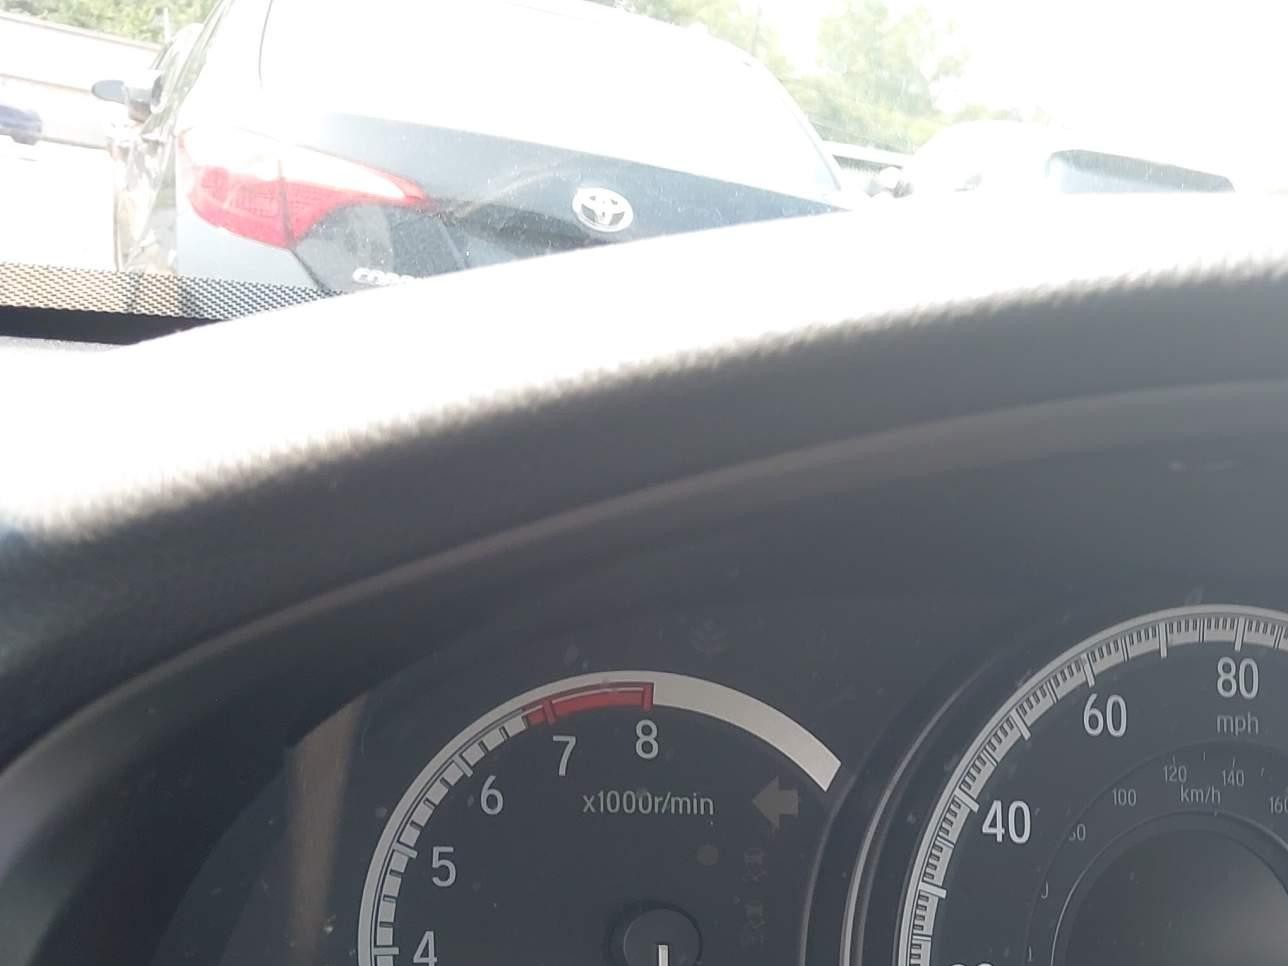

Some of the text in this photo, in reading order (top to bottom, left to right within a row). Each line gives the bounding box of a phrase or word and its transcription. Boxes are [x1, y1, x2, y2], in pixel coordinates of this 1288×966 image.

[1217, 656, 1259, 699] 80
[1083, 693, 1127, 737] 60
[1216, 711, 1259, 737] mph
[552, 735, 577, 777] 7
[635, 719, 659, 759] 8
[1164, 765, 1187, 783] 120
[1180, 783, 1221, 804] km/h
[1222, 769, 1245, 787] 140
[480, 775, 504, 815] 6
[583, 790, 714, 816] x1000r/min
[1112, 789, 1137, 807] 100
[982, 799, 1031, 844] 40
[431, 846, 457, 887] 5
